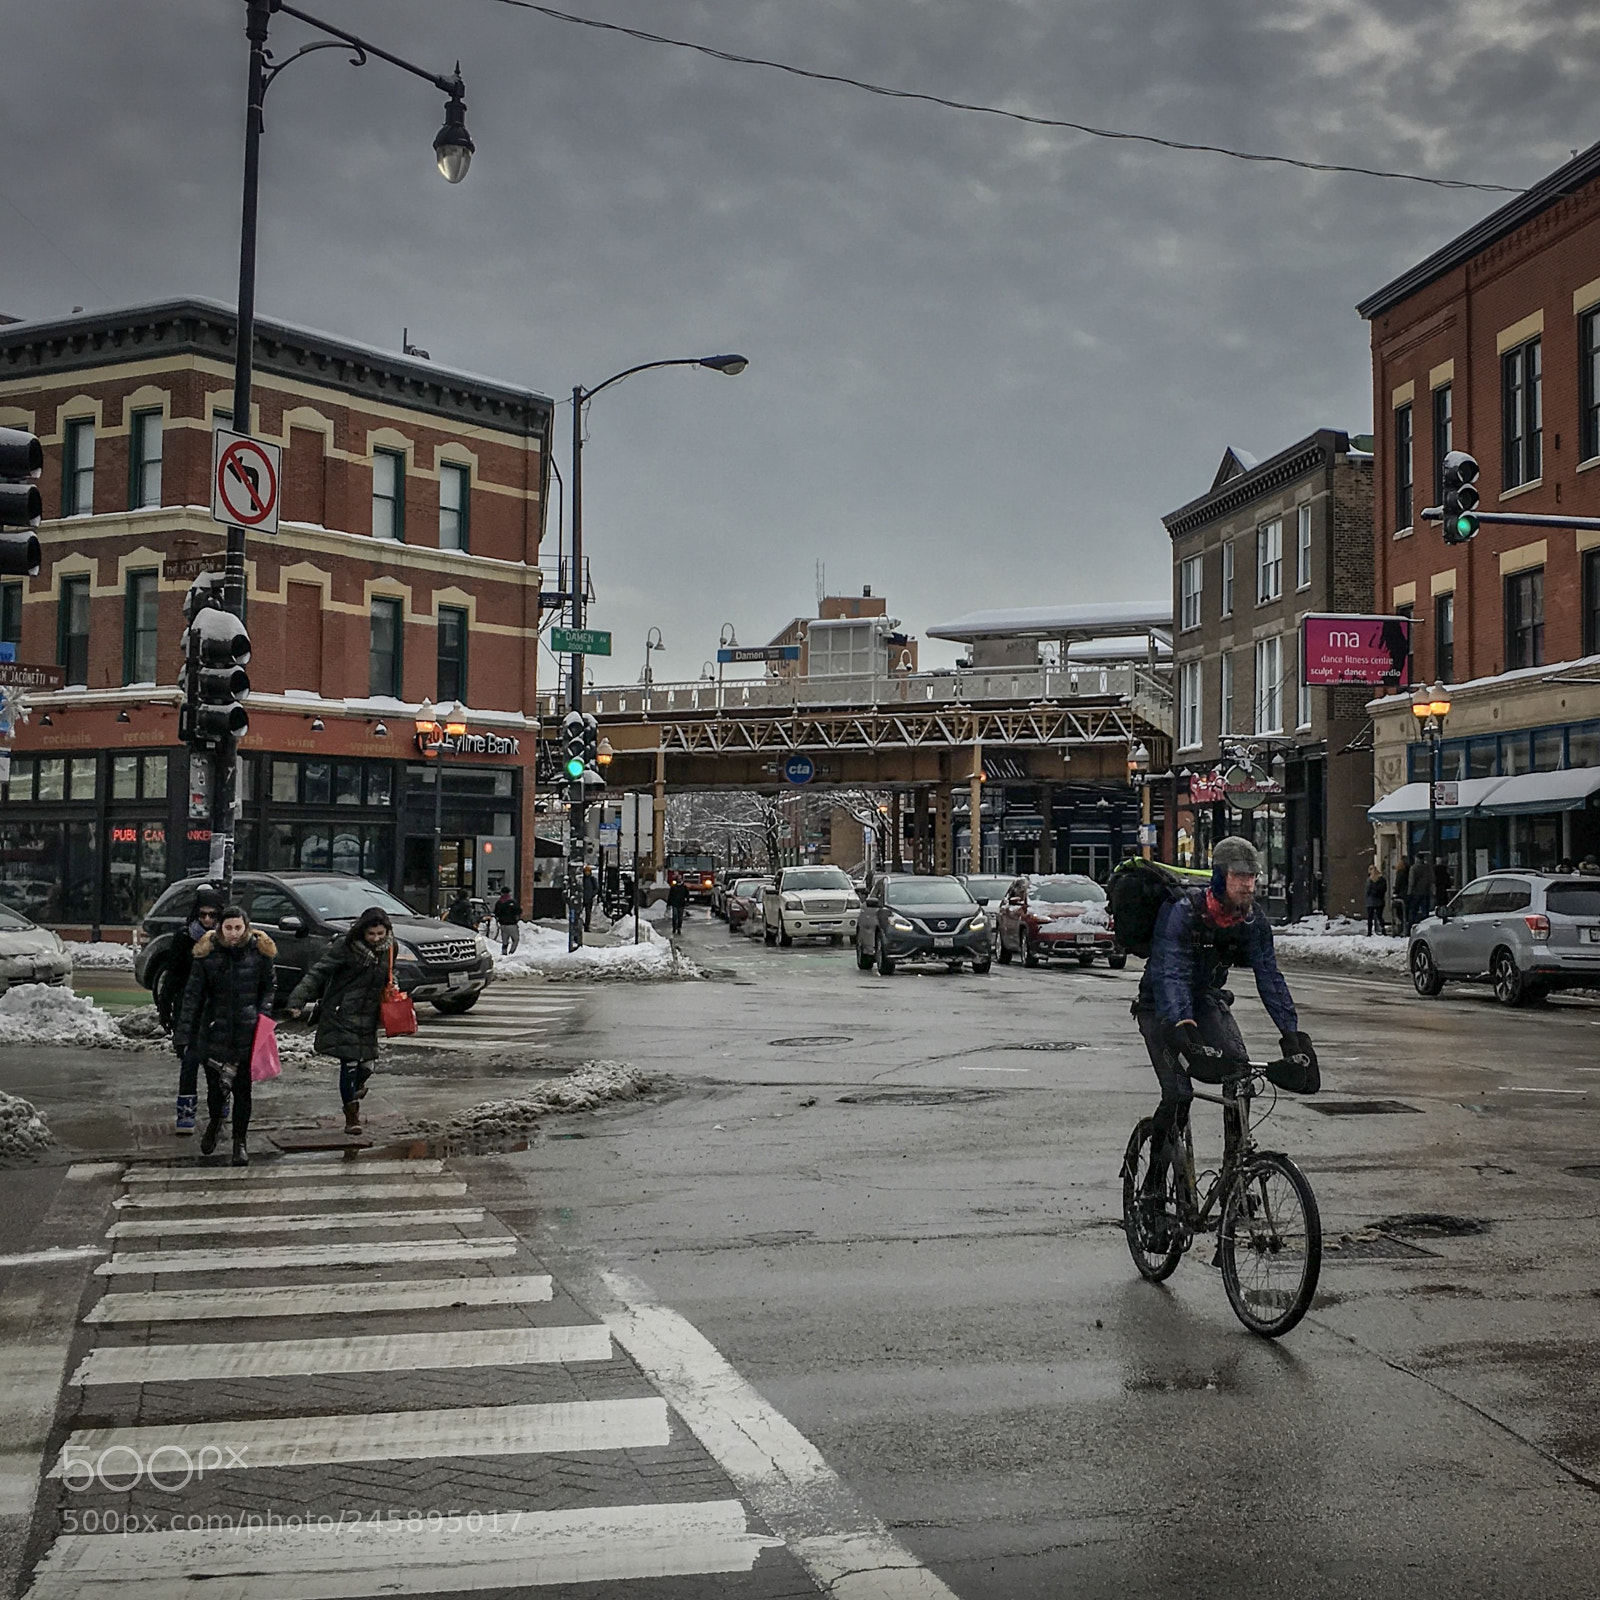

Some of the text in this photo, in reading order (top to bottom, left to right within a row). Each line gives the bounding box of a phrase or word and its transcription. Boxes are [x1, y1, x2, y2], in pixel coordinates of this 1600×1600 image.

[565, 631, 594, 643] DAMEN
[1329, 631, 1360, 648] ma
[735, 650, 764, 660] Damen
[1321, 654, 1394, 665] dance fitness centre
[1310, 667, 1401, 677] sculpt dance cardio
[238, 732, 263, 746] ish
[487, 732, 520, 755] Bank
[789, 763, 810, 775] cta
